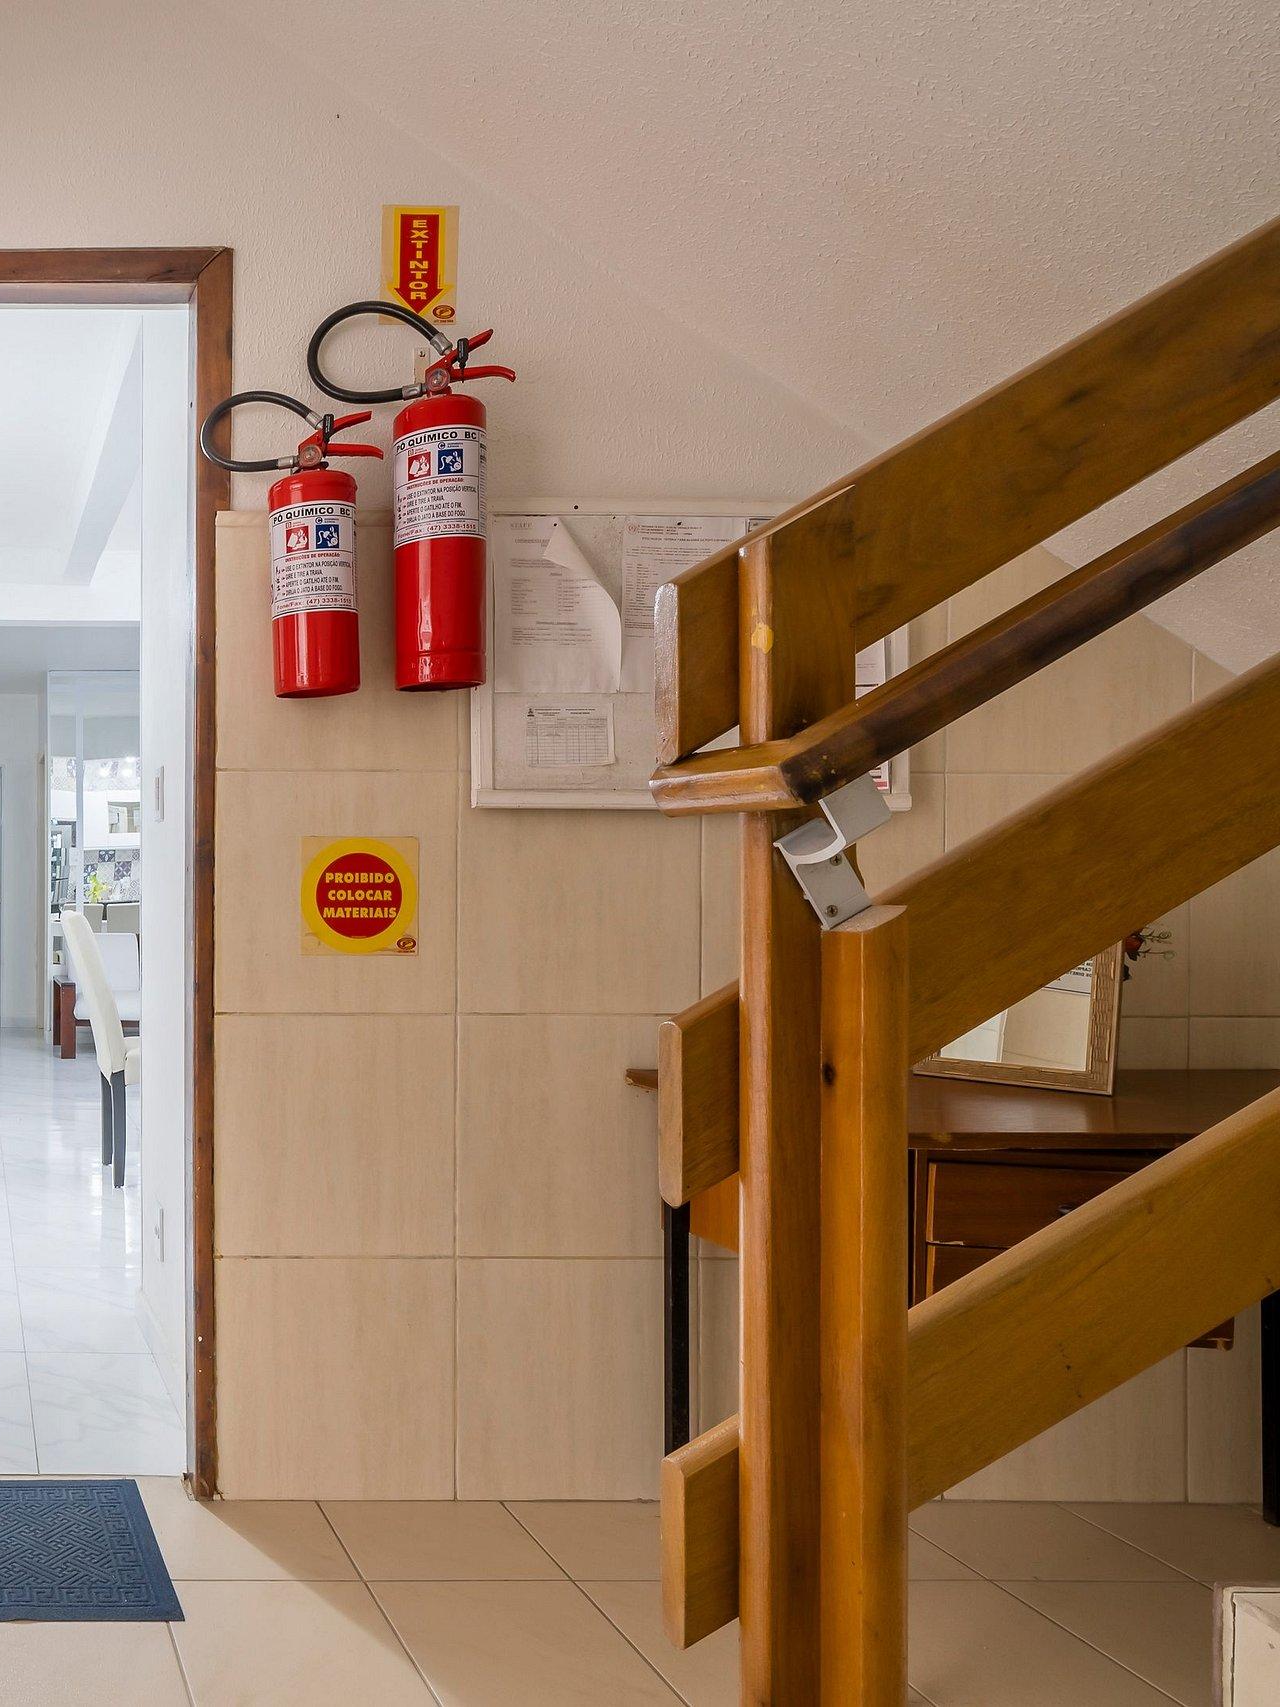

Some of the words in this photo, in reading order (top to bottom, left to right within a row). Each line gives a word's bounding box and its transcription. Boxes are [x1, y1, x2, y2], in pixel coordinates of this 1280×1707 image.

[408, 220, 429, 300] EXTINTOR
[408, 431, 457, 446] QUÍMICO
[465, 431, 476, 439] BC
[417, 488, 436, 497] EXTINTOR
[286, 507, 334, 519] QUÍMICO
[340, 508, 350, 516] BC
[326, 872, 394, 883] PROIBIDO
[328, 890, 392, 900] COLOCAR
[323, 907, 396, 918] MATERIAIS
